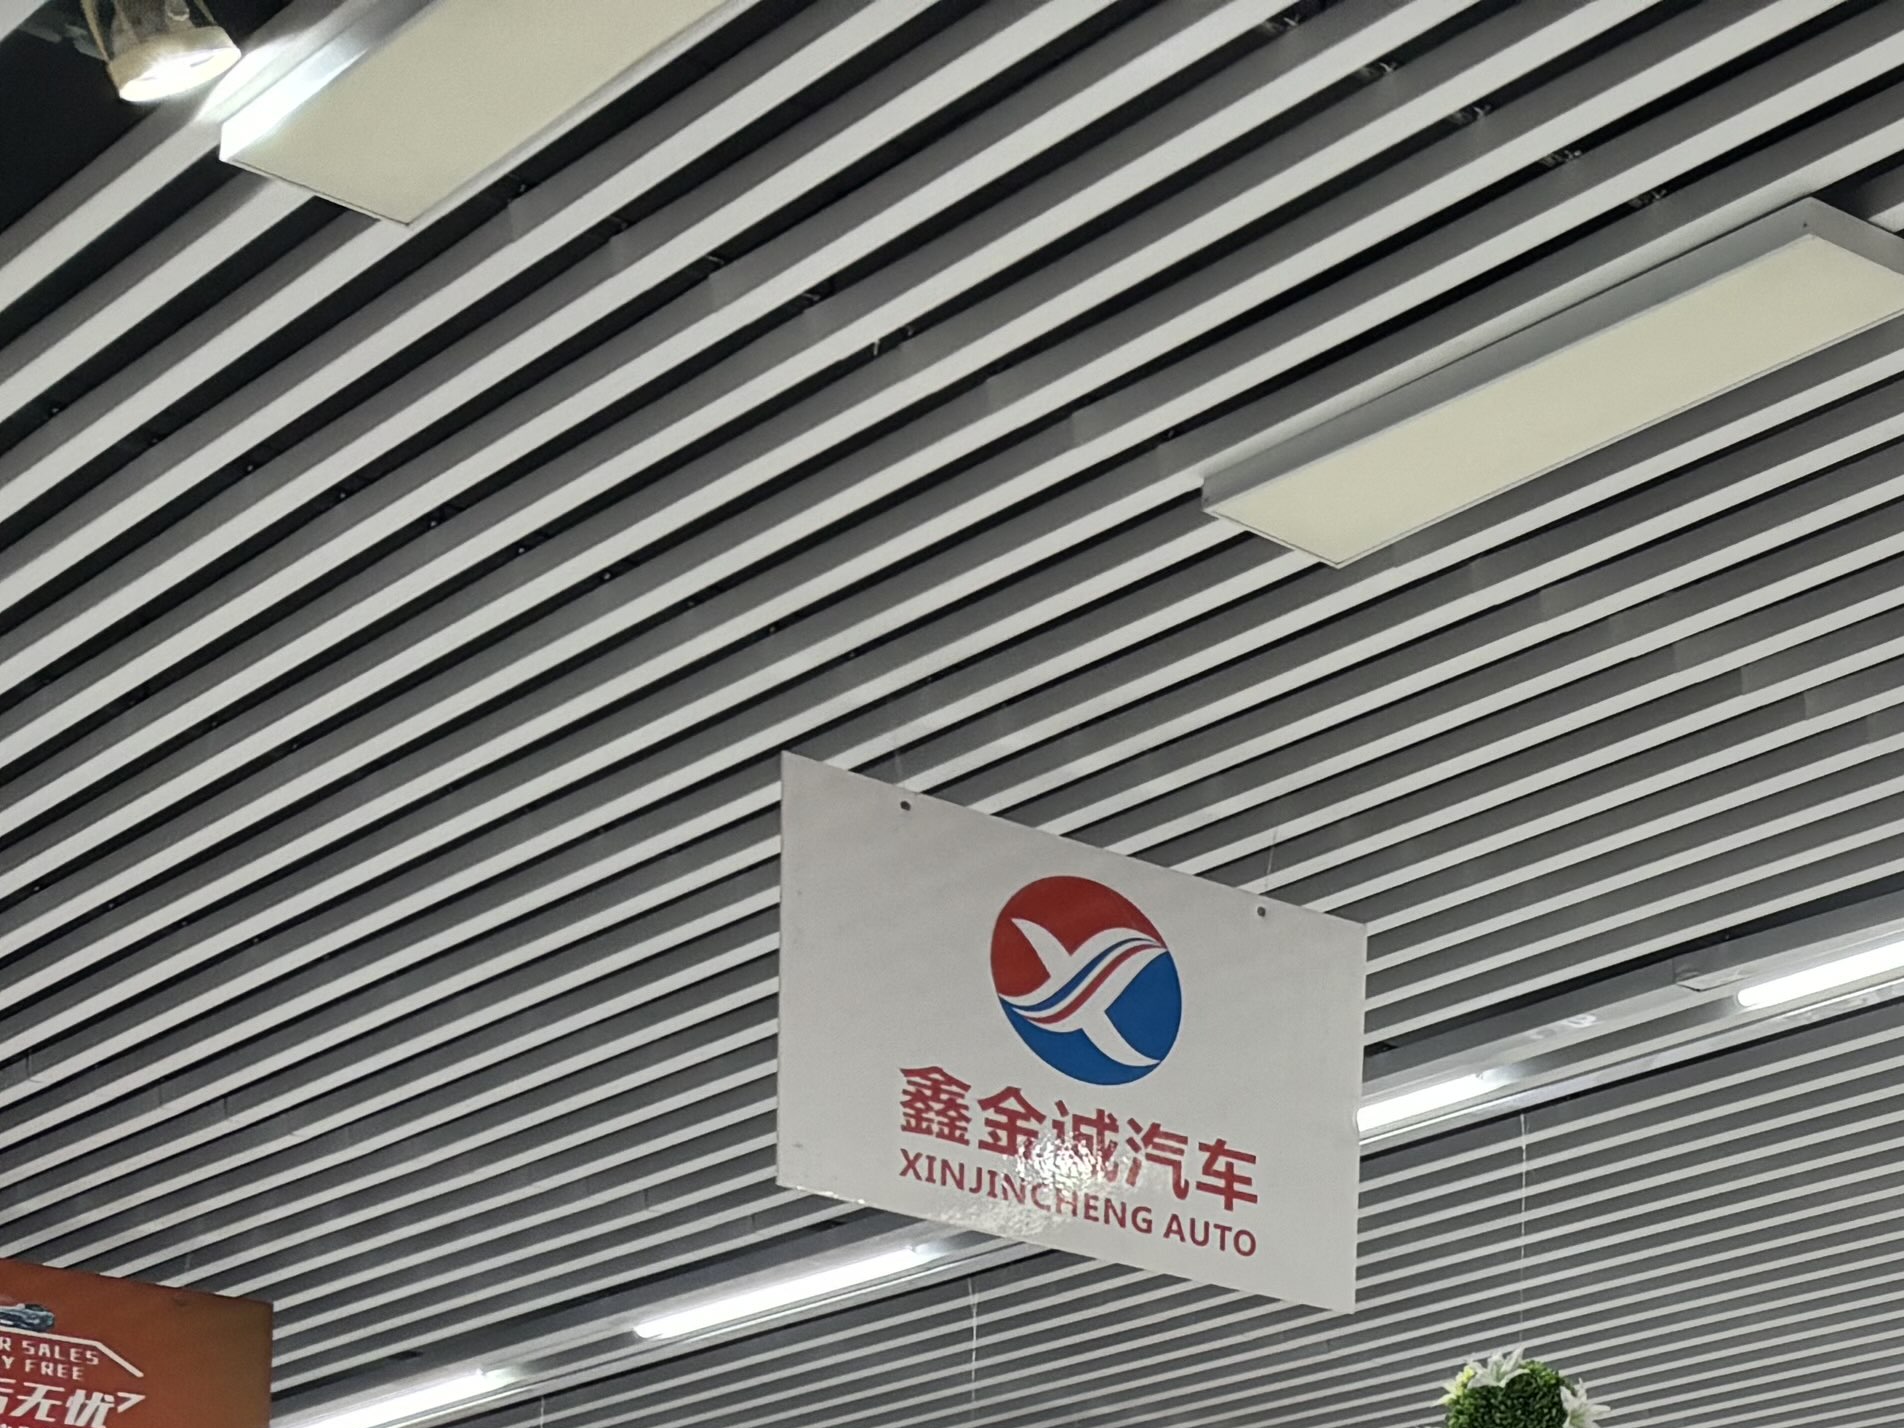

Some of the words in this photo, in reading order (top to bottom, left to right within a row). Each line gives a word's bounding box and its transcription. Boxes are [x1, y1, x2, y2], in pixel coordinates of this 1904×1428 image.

[899, 1066, 1258, 1211] 鑫金诚汽车
[899, 1148, 1153, 1234] XINJINCHENG
[1162, 1213, 1256, 1257] AUTO
[22, 1340, 99, 1365] SALES
[25, 1360, 84, 1380] FREE
